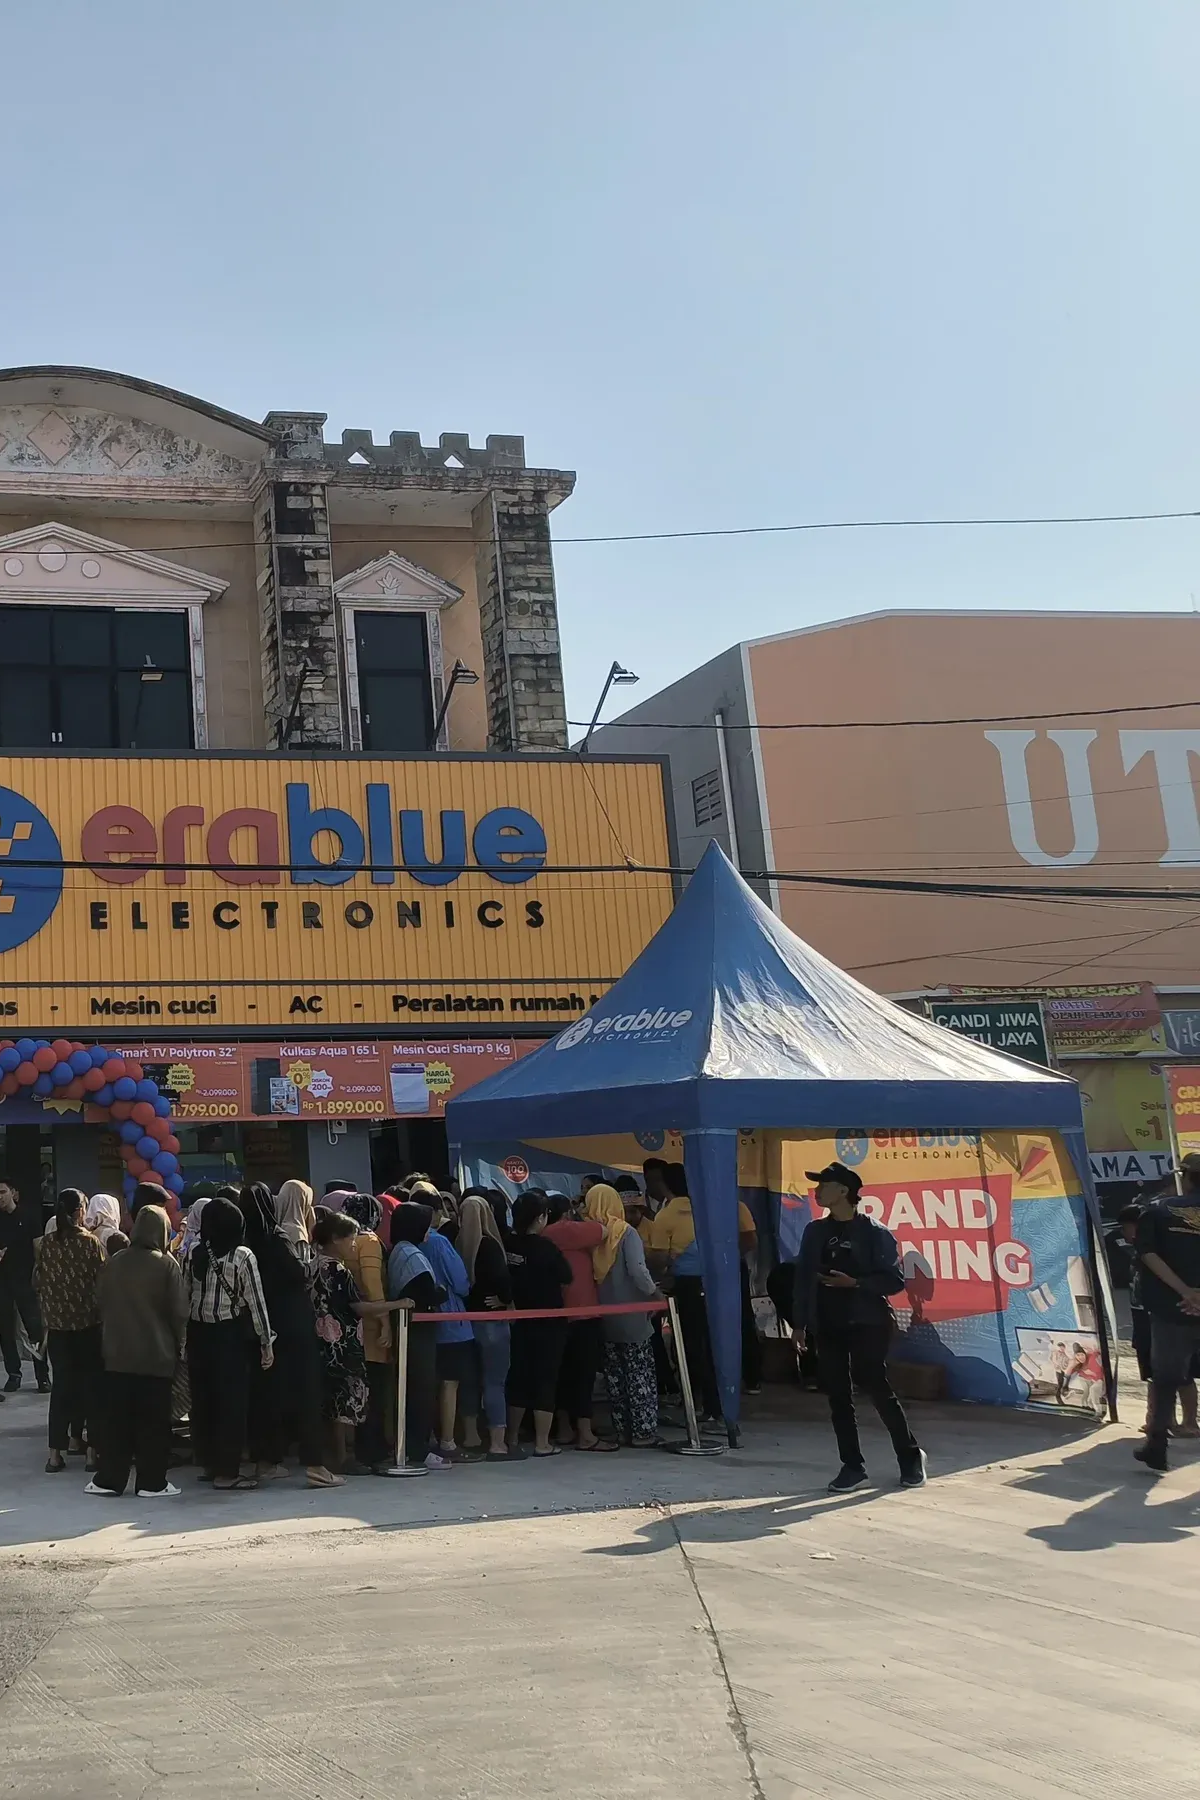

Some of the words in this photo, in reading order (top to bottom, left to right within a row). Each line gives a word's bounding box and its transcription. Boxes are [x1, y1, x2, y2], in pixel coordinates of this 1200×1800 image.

[81, 783, 547, 885] erablue
[90, 900, 545, 929] ELECTRONICS
[90, 995, 160, 1015] Mesin
[168, 995, 217, 1015] cuci
[289, 995, 323, 1013] AC
[392, 992, 505, 1012] Peralatan
[510, 992, 585, 1011] rumah
[1051, 1000, 1094, 1010] GRATIS
[593, 1007, 693, 1034] erablue
[936, 1013, 991, 1028] CANDI
[996, 1012, 1040, 1027] JIWA
[997, 1031, 1039, 1047] JAYA
[115, 1048, 149, 1058] Smart
[151, 1048, 167, 1057] TV
[169, 1047, 216, 1059] Polytron
[280, 1046, 316, 1057] Kulkas
[319, 1046, 347, 1058] Aqua
[350, 1045, 369, 1055] 165
[372, 1046, 379, 1055] L
[393, 1045, 424, 1054] Mesin
[426, 1044, 450, 1054] Cuci
[453, 1043, 485, 1055] Sharp
[486, 1044, 493, 1053] 9
[496, 1043, 511, 1055] Kg
[202, 1089, 238, 1097] 2.099.000
[170, 1104, 239, 1117] 1.799.000
[302, 1101, 314, 1111] Rp
[316, 1101, 385, 1114] 1.899.000
[1136, 1128, 1150, 1138] Rp
[875, 1150, 981, 1160] ELECTRONICS
[823, 1188, 998, 1231] RAND
[899, 1240, 1032, 1285] NING
